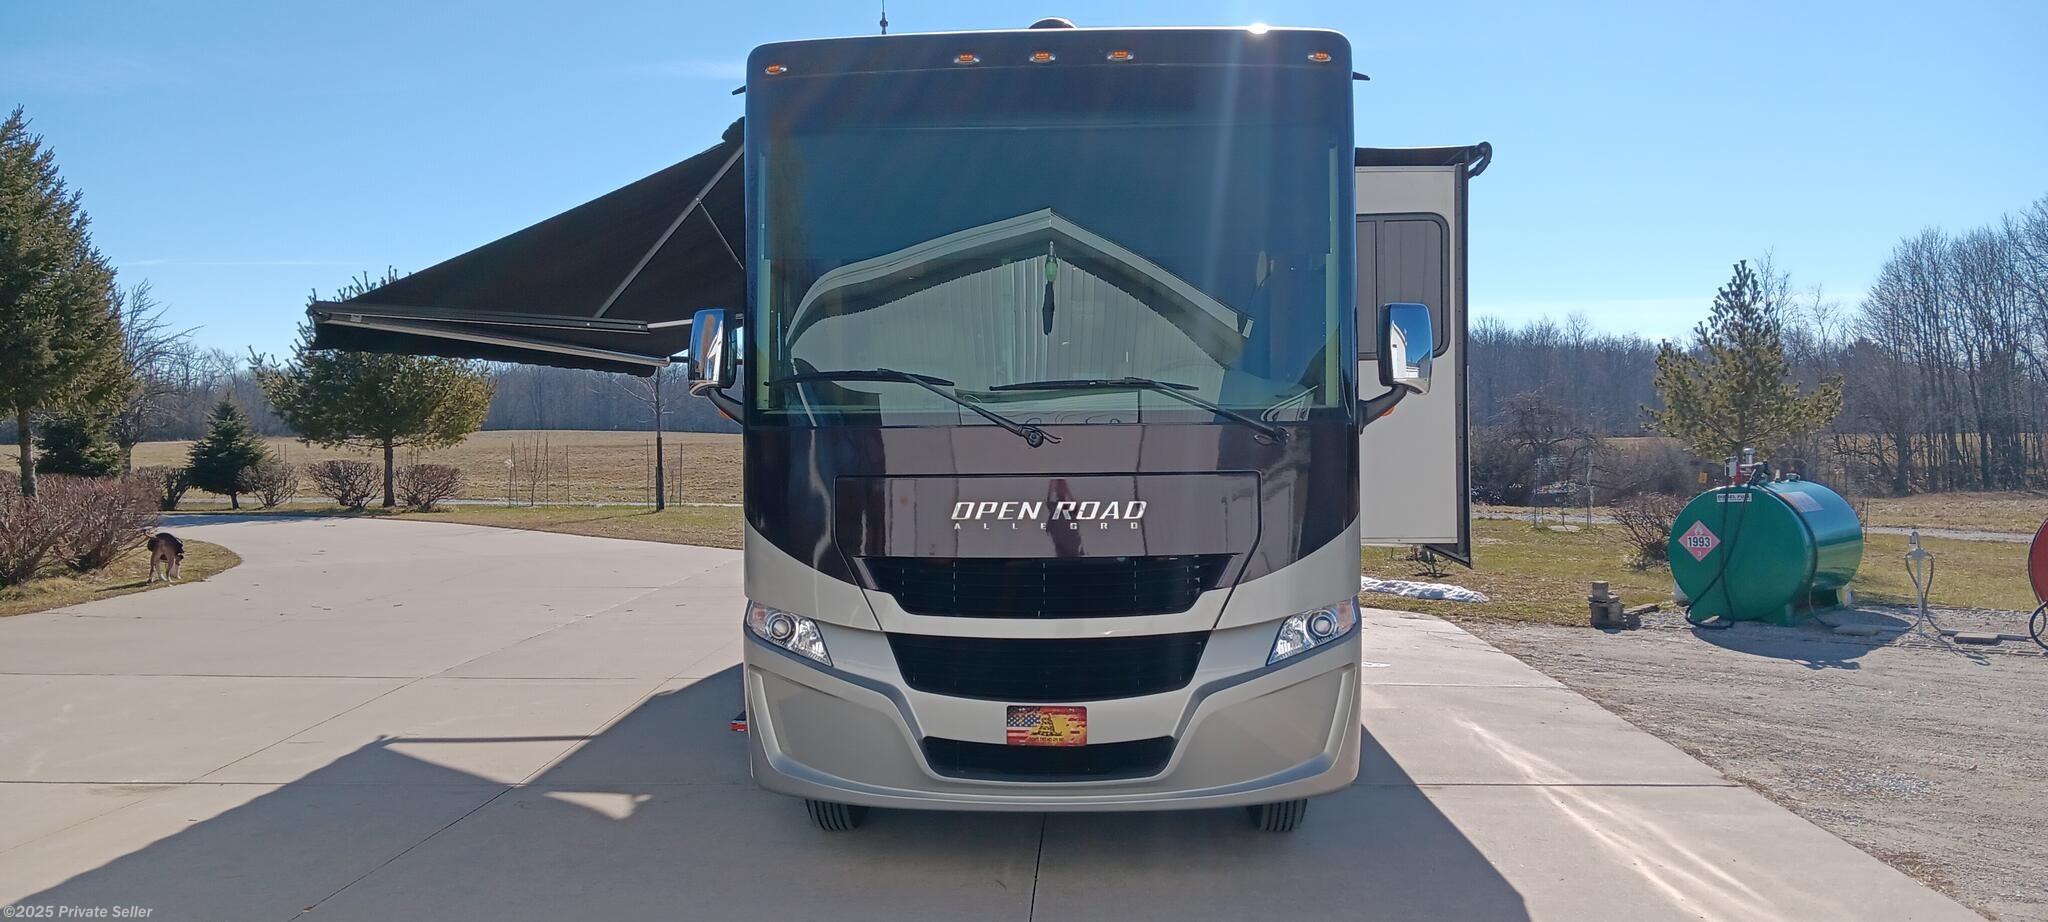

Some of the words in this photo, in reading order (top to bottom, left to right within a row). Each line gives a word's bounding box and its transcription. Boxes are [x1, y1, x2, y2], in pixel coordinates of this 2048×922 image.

[951, 501, 1043, 520] OPEN
[1052, 500, 1148, 520] ROAD
[953, 522, 1139, 530] ALLEGRO
[1688, 536, 1710, 547] 1993
